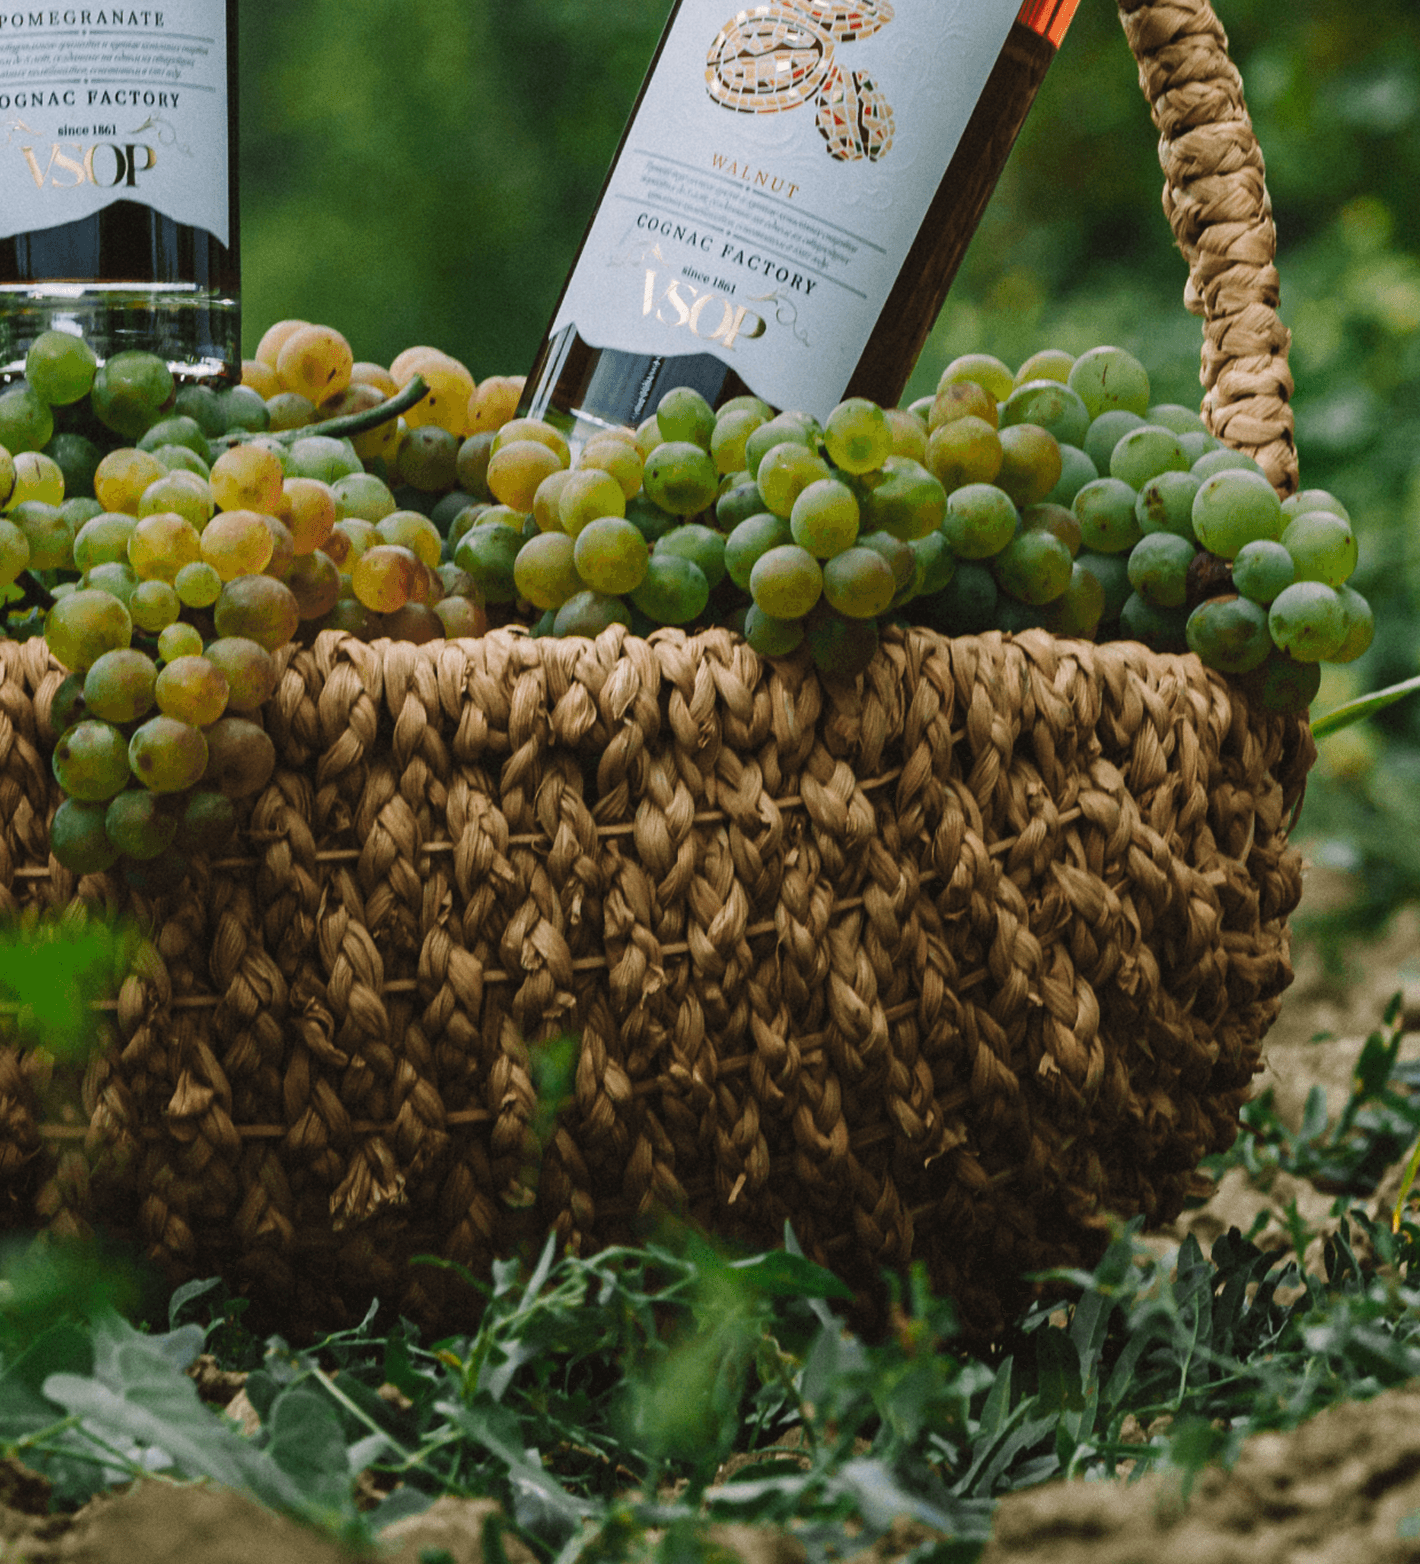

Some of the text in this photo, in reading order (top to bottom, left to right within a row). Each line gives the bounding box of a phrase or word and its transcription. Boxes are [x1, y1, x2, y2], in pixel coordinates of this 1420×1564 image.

[86, 89, 181, 109] FACTORY
[57, 124, 117, 136] since 1861
[17, 142, 158, 189] VSOP
[711, 152, 799, 199] WALNUT
[636, 213, 713, 251] COGNAC
[720, 243, 818, 296] FACTORY
[681, 264, 736, 294] since 1861
[642, 268, 767, 352] VSOP
